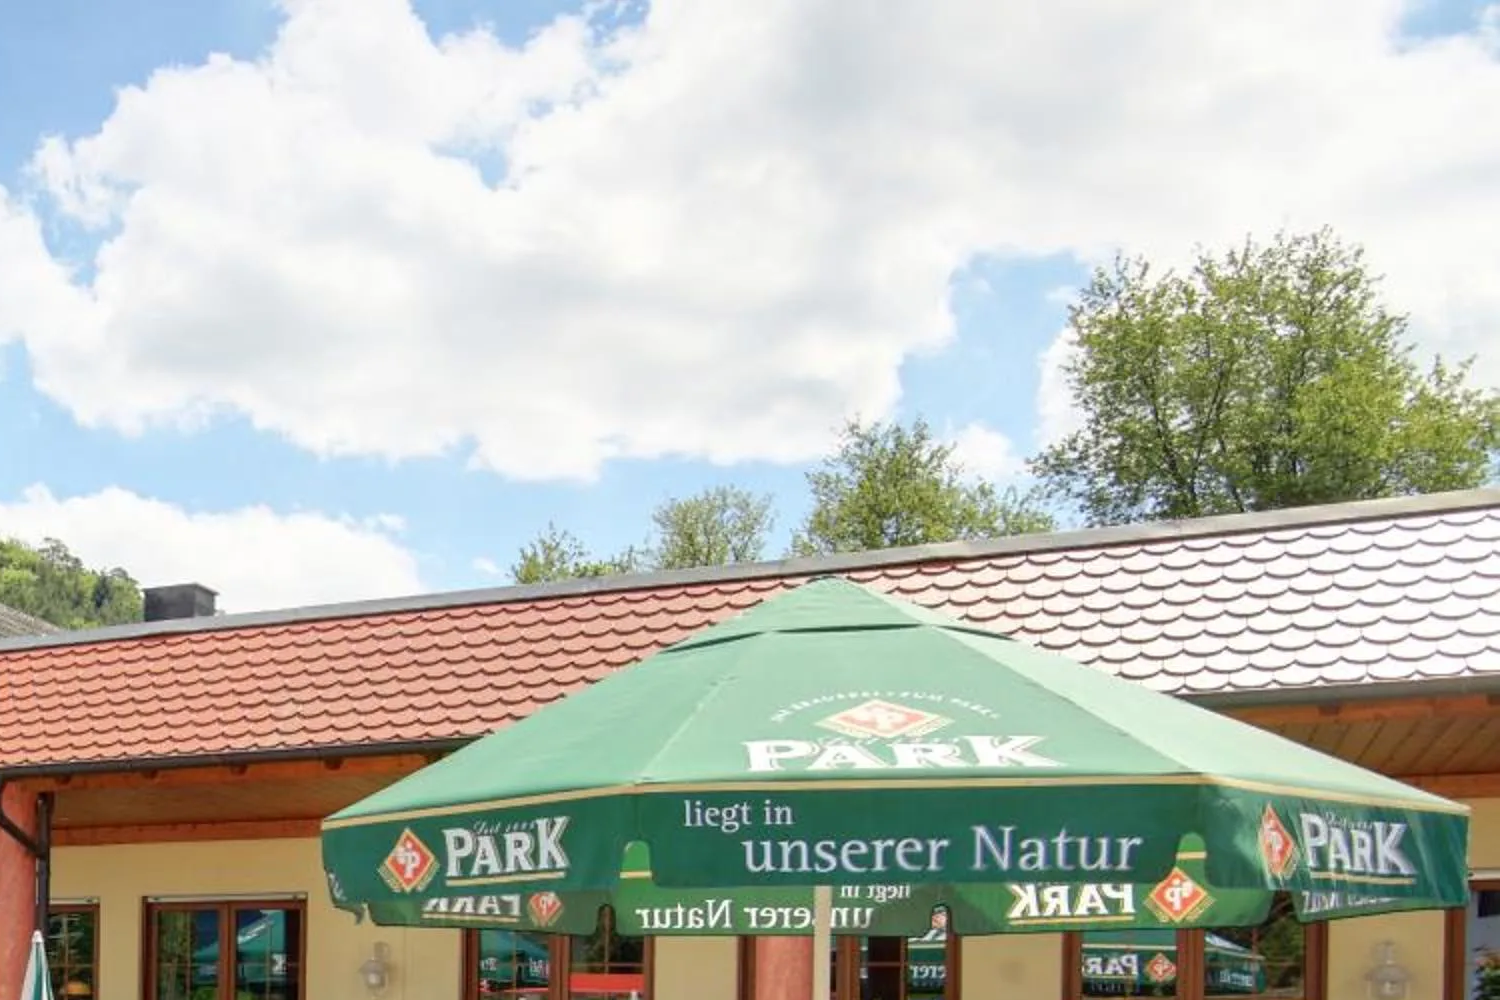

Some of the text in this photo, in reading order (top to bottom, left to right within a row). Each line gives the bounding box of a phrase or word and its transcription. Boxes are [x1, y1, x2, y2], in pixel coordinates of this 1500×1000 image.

[741, 734, 1068, 772] PARK
[683, 798, 795, 833] liegt in
[441, 815, 570, 877] PARK
[740, 824, 1145, 873] unserer Natur
[1299, 812, 1418, 877] PARK
